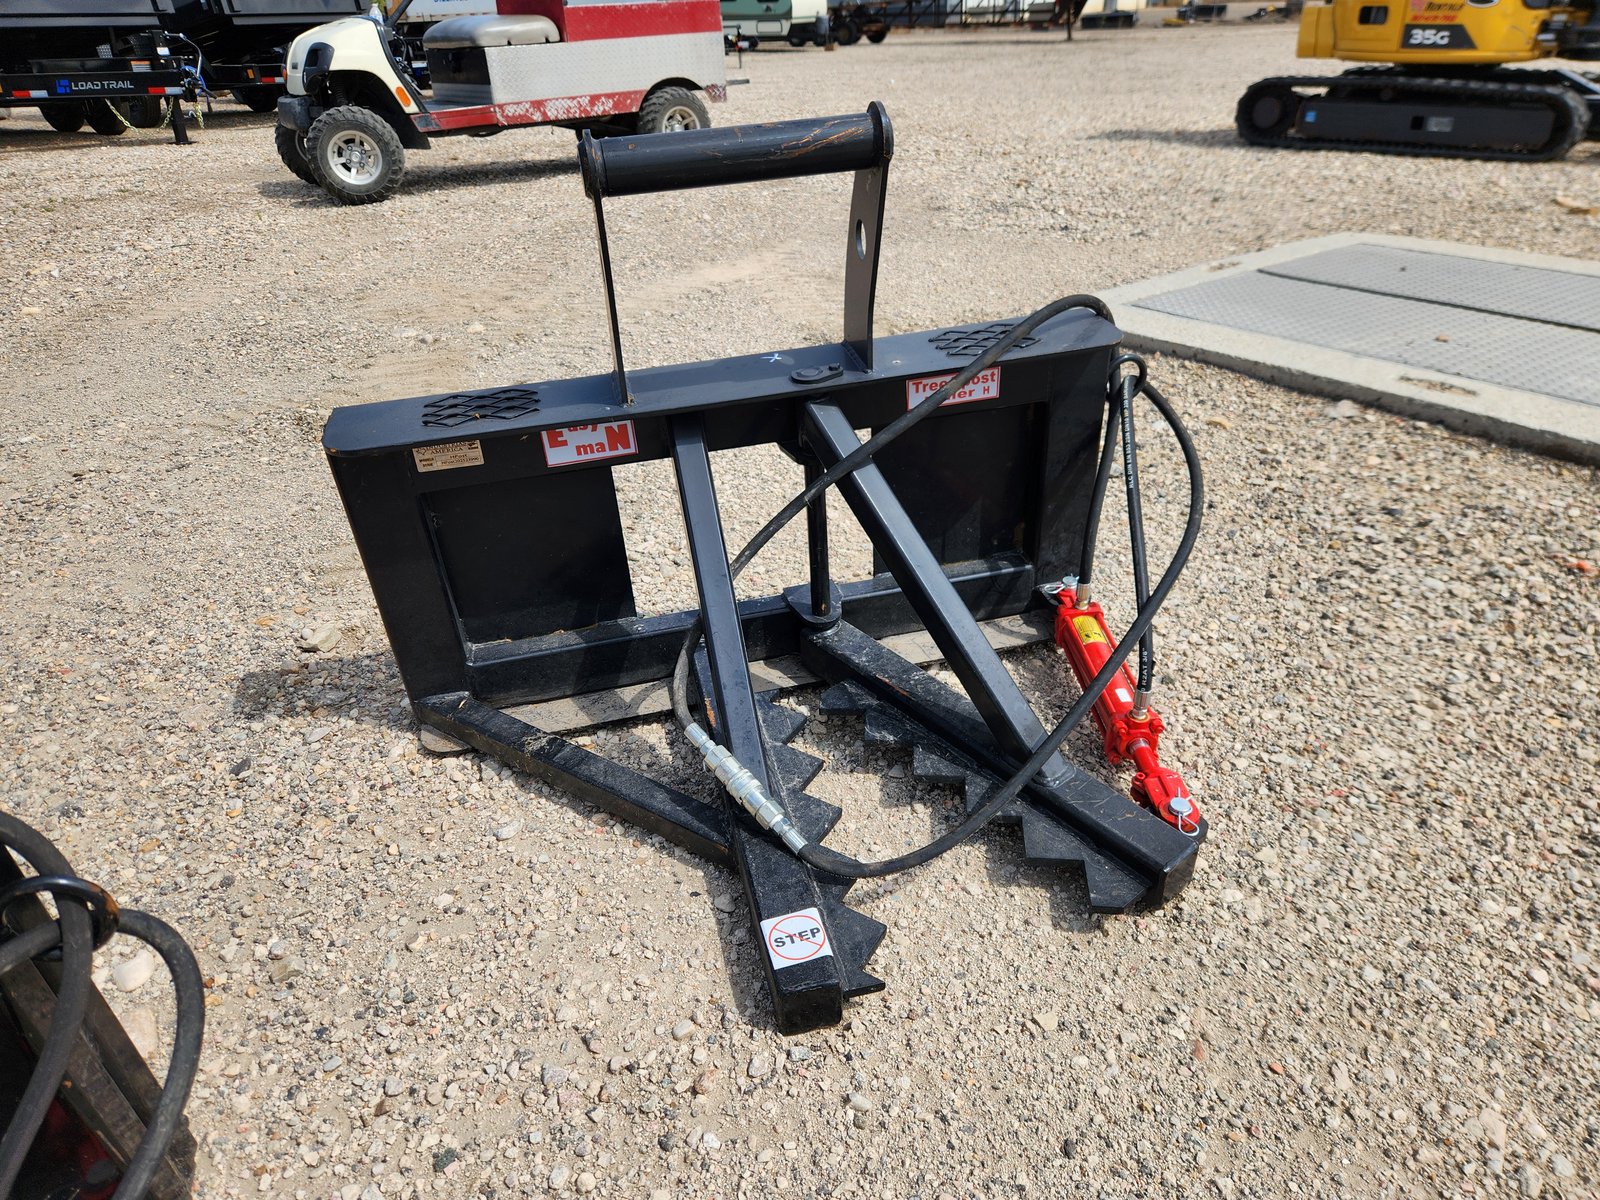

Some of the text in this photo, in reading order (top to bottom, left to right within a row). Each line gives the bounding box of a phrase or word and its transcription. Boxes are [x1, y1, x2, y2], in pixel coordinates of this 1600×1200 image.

[1409, 29, 1450, 44] 35G
[71, 80, 134, 90] LOAD TRAIL
[983, 386, 990, 395] H
[430, 446, 464, 455] AMERICA
[774, 927, 821, 947] STEP
